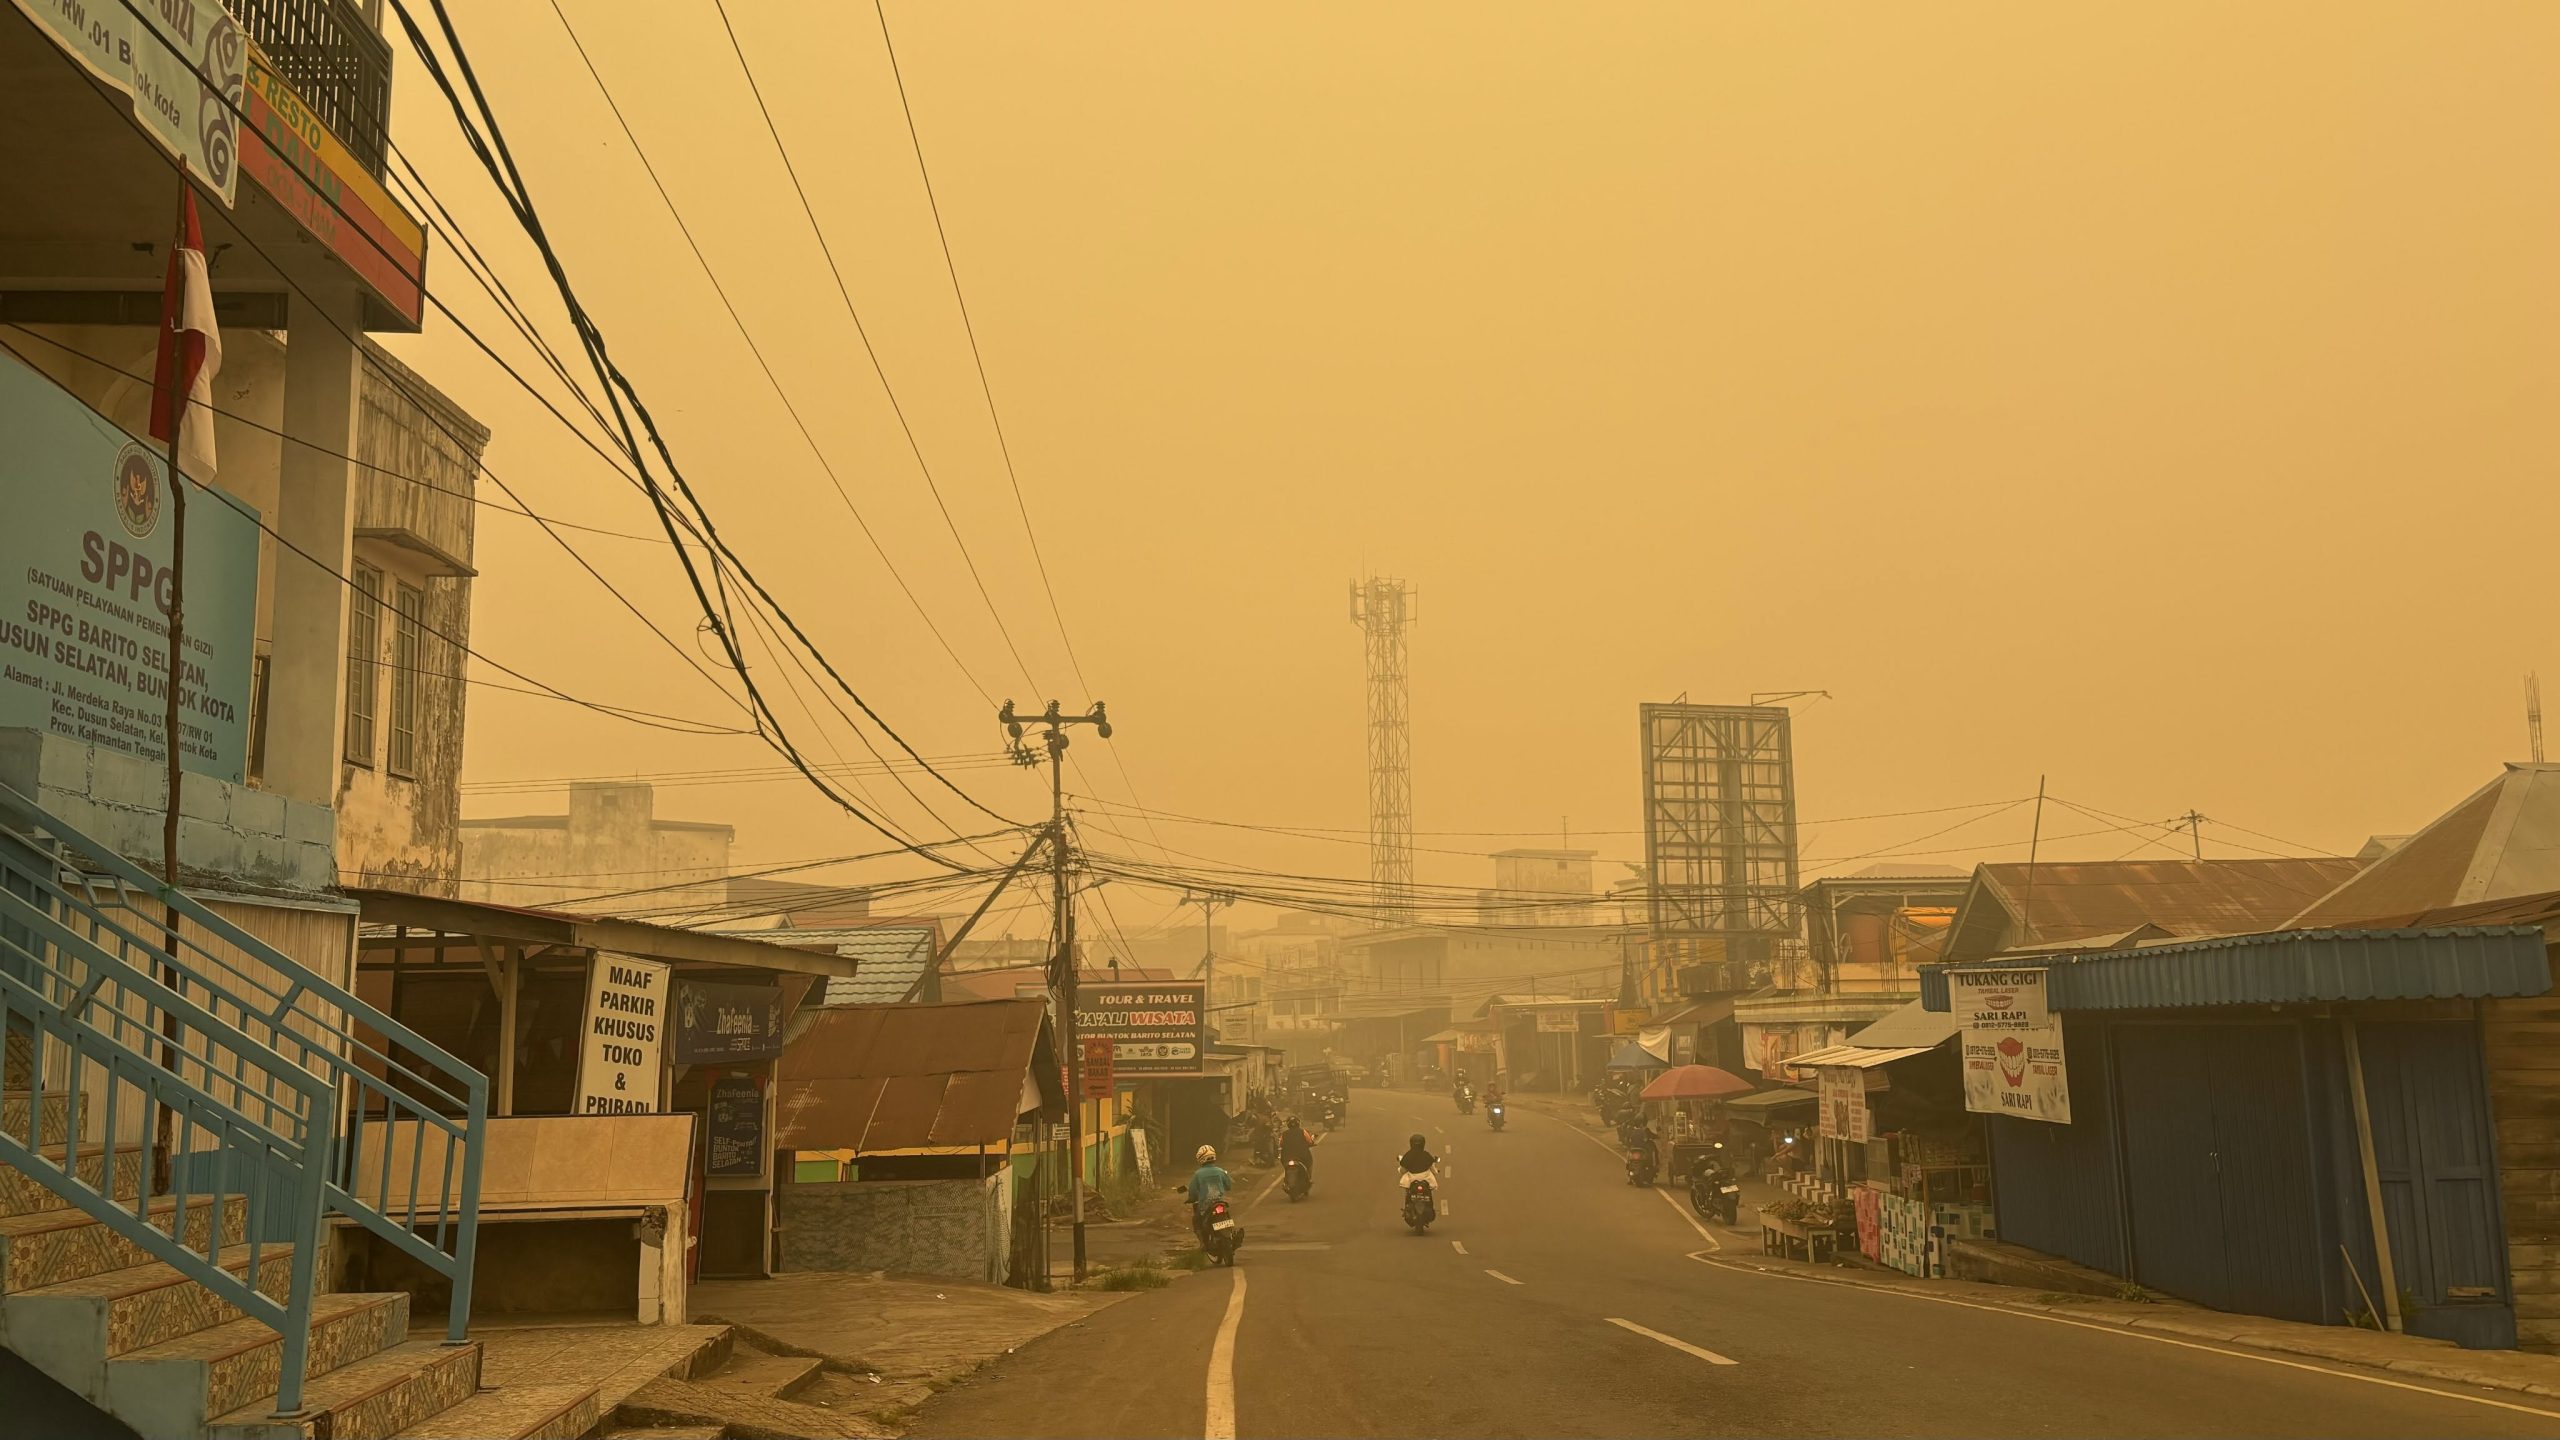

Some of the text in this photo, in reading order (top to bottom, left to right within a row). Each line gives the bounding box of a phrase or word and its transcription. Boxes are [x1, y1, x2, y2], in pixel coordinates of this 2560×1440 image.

[154, 84, 181, 128] kota
[265, 74, 321, 151] RESTO
[81, 530, 174, 615] SPPG
[27, 566, 74, 599] (SATUAN
[76, 588, 134, 625] PELAYANAN
[193, 639, 214, 661] GIZI)
[27, 600, 209, 692] SPPG BARITO SELTAN,
[54, 641, 132, 692] SELATAN,
[136, 672, 197, 711] BUNOK
[200, 694, 235, 724] KOTA
[3, 664, 43, 690] Alamat
[52, 680, 65, 698] Jl.
[68, 685, 109, 711] Merdeka
[112, 700, 135, 720] Raya
[137, 709, 162, 728] No.03
[204, 731, 213, 745] 01
[50, 716, 166, 761] Prov. Kalimantan Tengah
[52, 698, 75, 718] Kec.
[78, 707, 107, 728] Dusun
[110, 716, 147, 742] Selatan,
[149, 730, 166, 746] Kel.
[199, 744, 218, 761] Kota
[609, 966, 653, 989] MAAF
[1960, 973, 2037, 987] TUKANG GIGI
[600, 990, 655, 1016] PARKIR
[1099, 994, 1195, 1005] TOUR & TRAVEL
[593, 1016, 655, 1042] KHUSUS
[1130, 1010, 1196, 1026] WISATA
[1974, 1011, 2026, 1021] SARI RAPI
[1131, 1031, 1160, 1040] BARITO
[1161, 1031, 1196, 1039] SELATAN
[602, 1044, 643, 1066] TOKO
[614, 1072, 626, 1091] &
[2001, 1091, 2032, 1110] SARI RAPI
